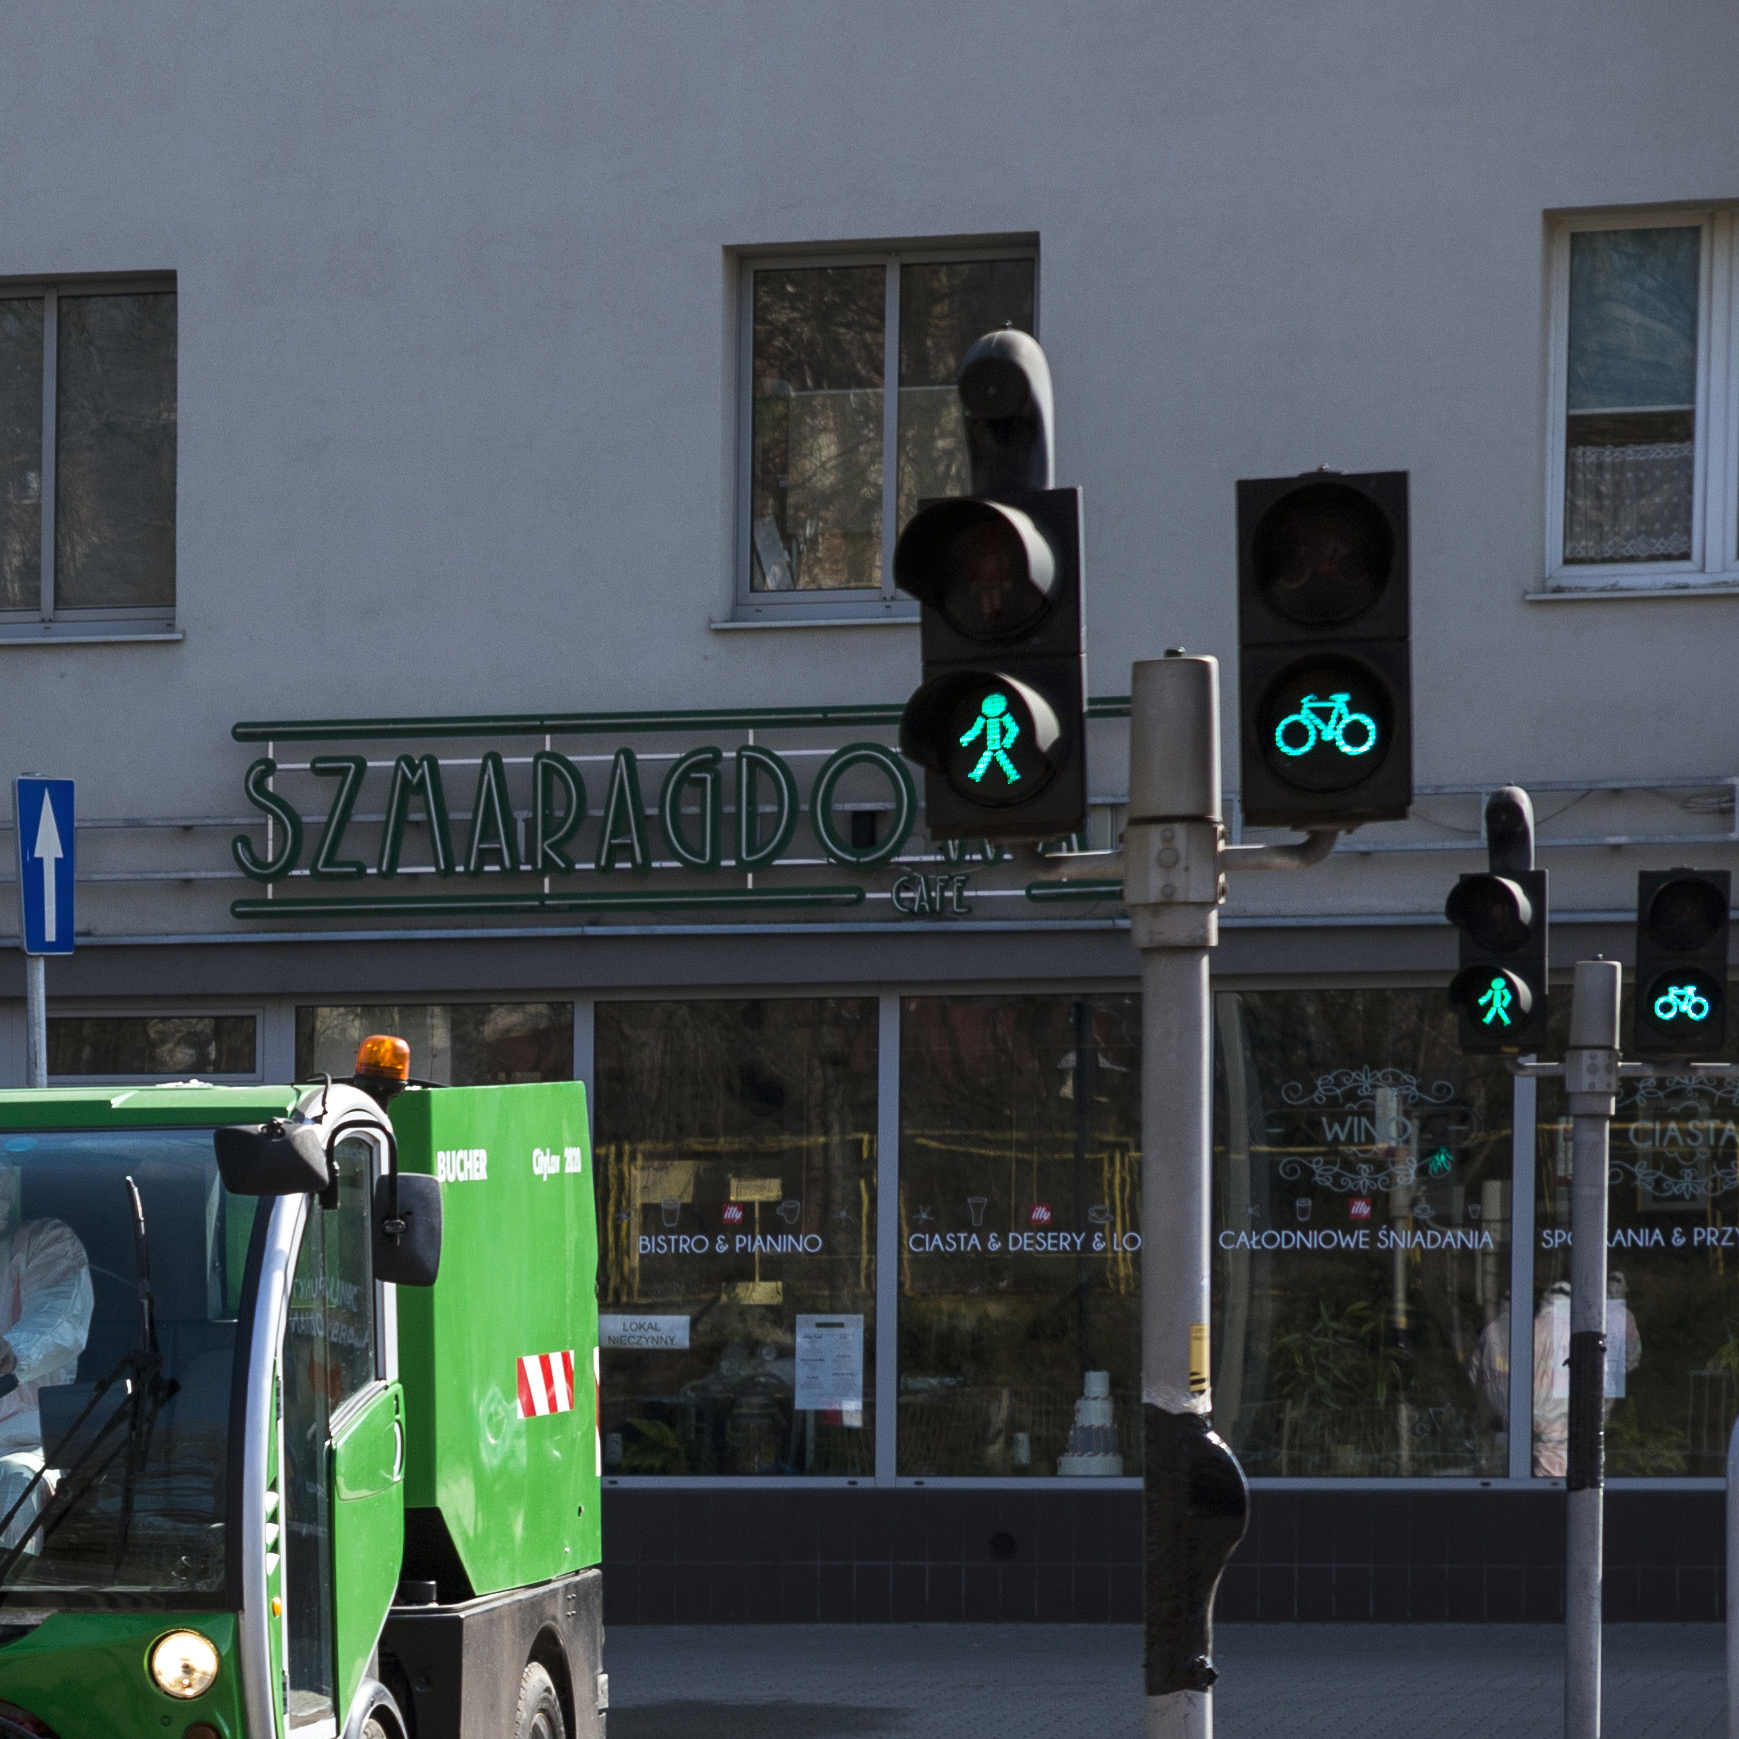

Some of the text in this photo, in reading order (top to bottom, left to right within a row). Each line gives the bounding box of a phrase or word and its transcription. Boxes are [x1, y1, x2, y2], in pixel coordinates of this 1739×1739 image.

[891, 872, 973, 916] CAFE
[1321, 1115, 1413, 1145] WINO
[436, 1148, 488, 1183] BUCHER
[724, 1205, 743, 1222] illy
[1032, 1205, 1051, 1222] illy
[1350, 1201, 1371, 1218] illy
[639, 1233, 823, 1254] BISTRO & PIANINO
[909, 1232, 981, 1253] CIASTA
[988, 1233, 1002, 1252] &
[1008, 1232, 1085, 1252] DESERY
[1092, 1232, 1106, 1252] &
[1219, 1224, 1495, 1251] CAŁODNIOWE ŚNIADANIA
[1672, 1229, 1686, 1249] &
[622, 1321, 661, 1333] LOKAL
[607, 1334, 676, 1347] NIECZYNNY
